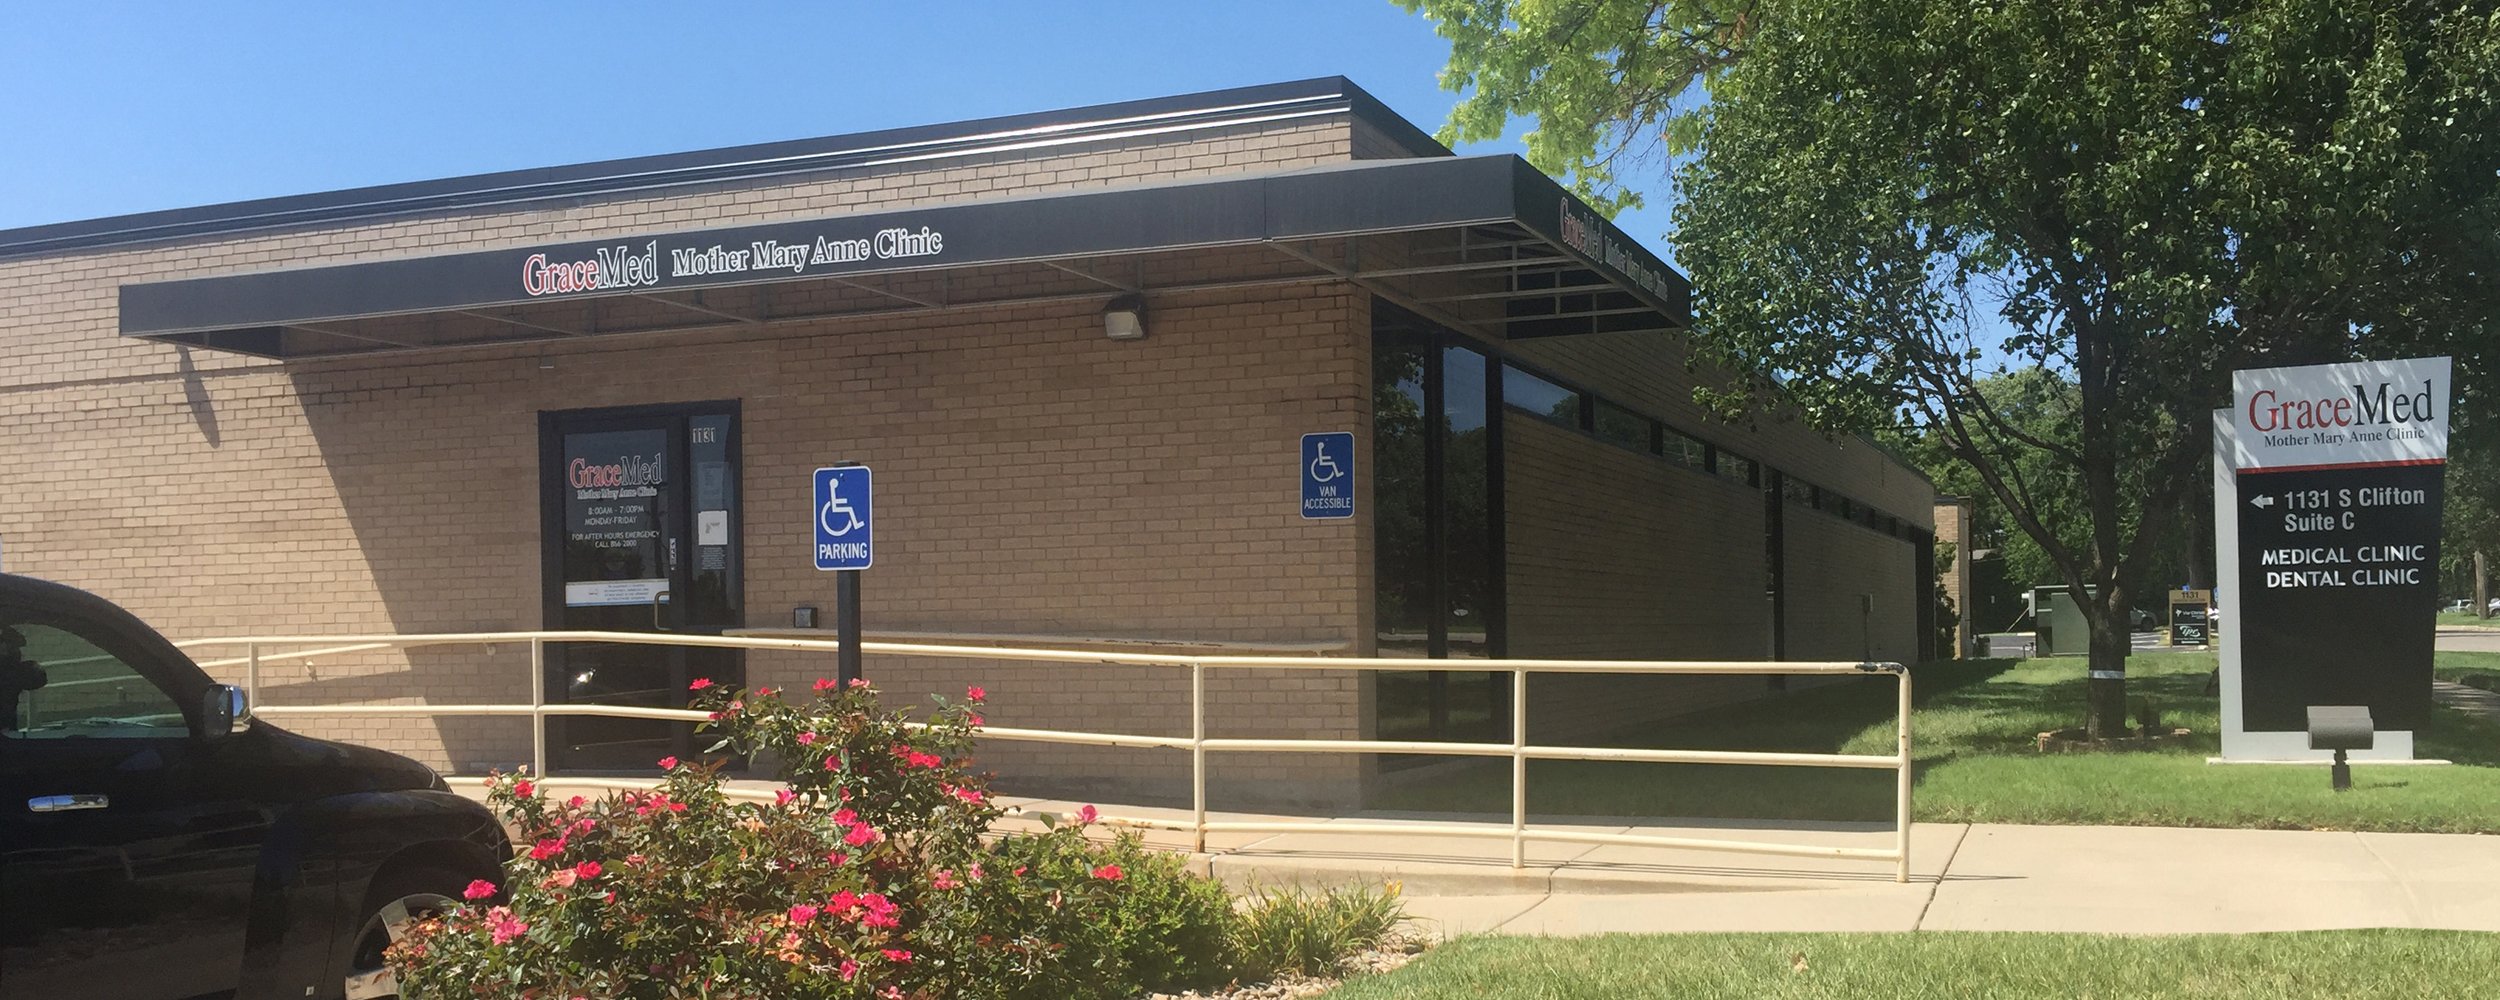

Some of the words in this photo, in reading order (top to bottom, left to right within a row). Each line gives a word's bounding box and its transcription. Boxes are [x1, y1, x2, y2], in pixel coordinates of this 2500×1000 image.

[523, 239, 658, 296] GraceMed
[672, 245, 749, 277] Mother
[752, 240, 809, 272] Mary
[811, 235, 871, 265] Anne
[874, 226, 943, 259] Clinic
[2249, 379, 2434, 432] GraceMed
[692, 427, 716, 444] 1131
[2264, 434, 2309, 448] Mother
[2313, 432, 2345, 446] Mary
[2350, 430, 2382, 443] Anne
[2386, 427, 2425, 440] Clinic
[569, 452, 662, 488] GraceMed
[1319, 485, 1337, 497] VAN
[2284, 489, 2330, 510] 1131
[2339, 488, 2352, 506] S
[2359, 486, 2425, 506] Clifton
[1304, 497, 1351, 510] ACCESSIBLE
[2284, 512, 2335, 532] Suite
[2342, 511, 2355, 530] C
[584, 532, 603, 540] AFTER
[604, 531, 624, 540] HOURS
[595, 540, 610, 548] CALL
[819, 542, 868, 560] PARKING
[2262, 547, 2351, 566] MEDICAL
[2357, 545, 2425, 562] CLINIC
[2266, 570, 2346, 588] DENTAL
[2352, 568, 2420, 586] CLINIC
[2181, 591, 2199, 599] 1131
